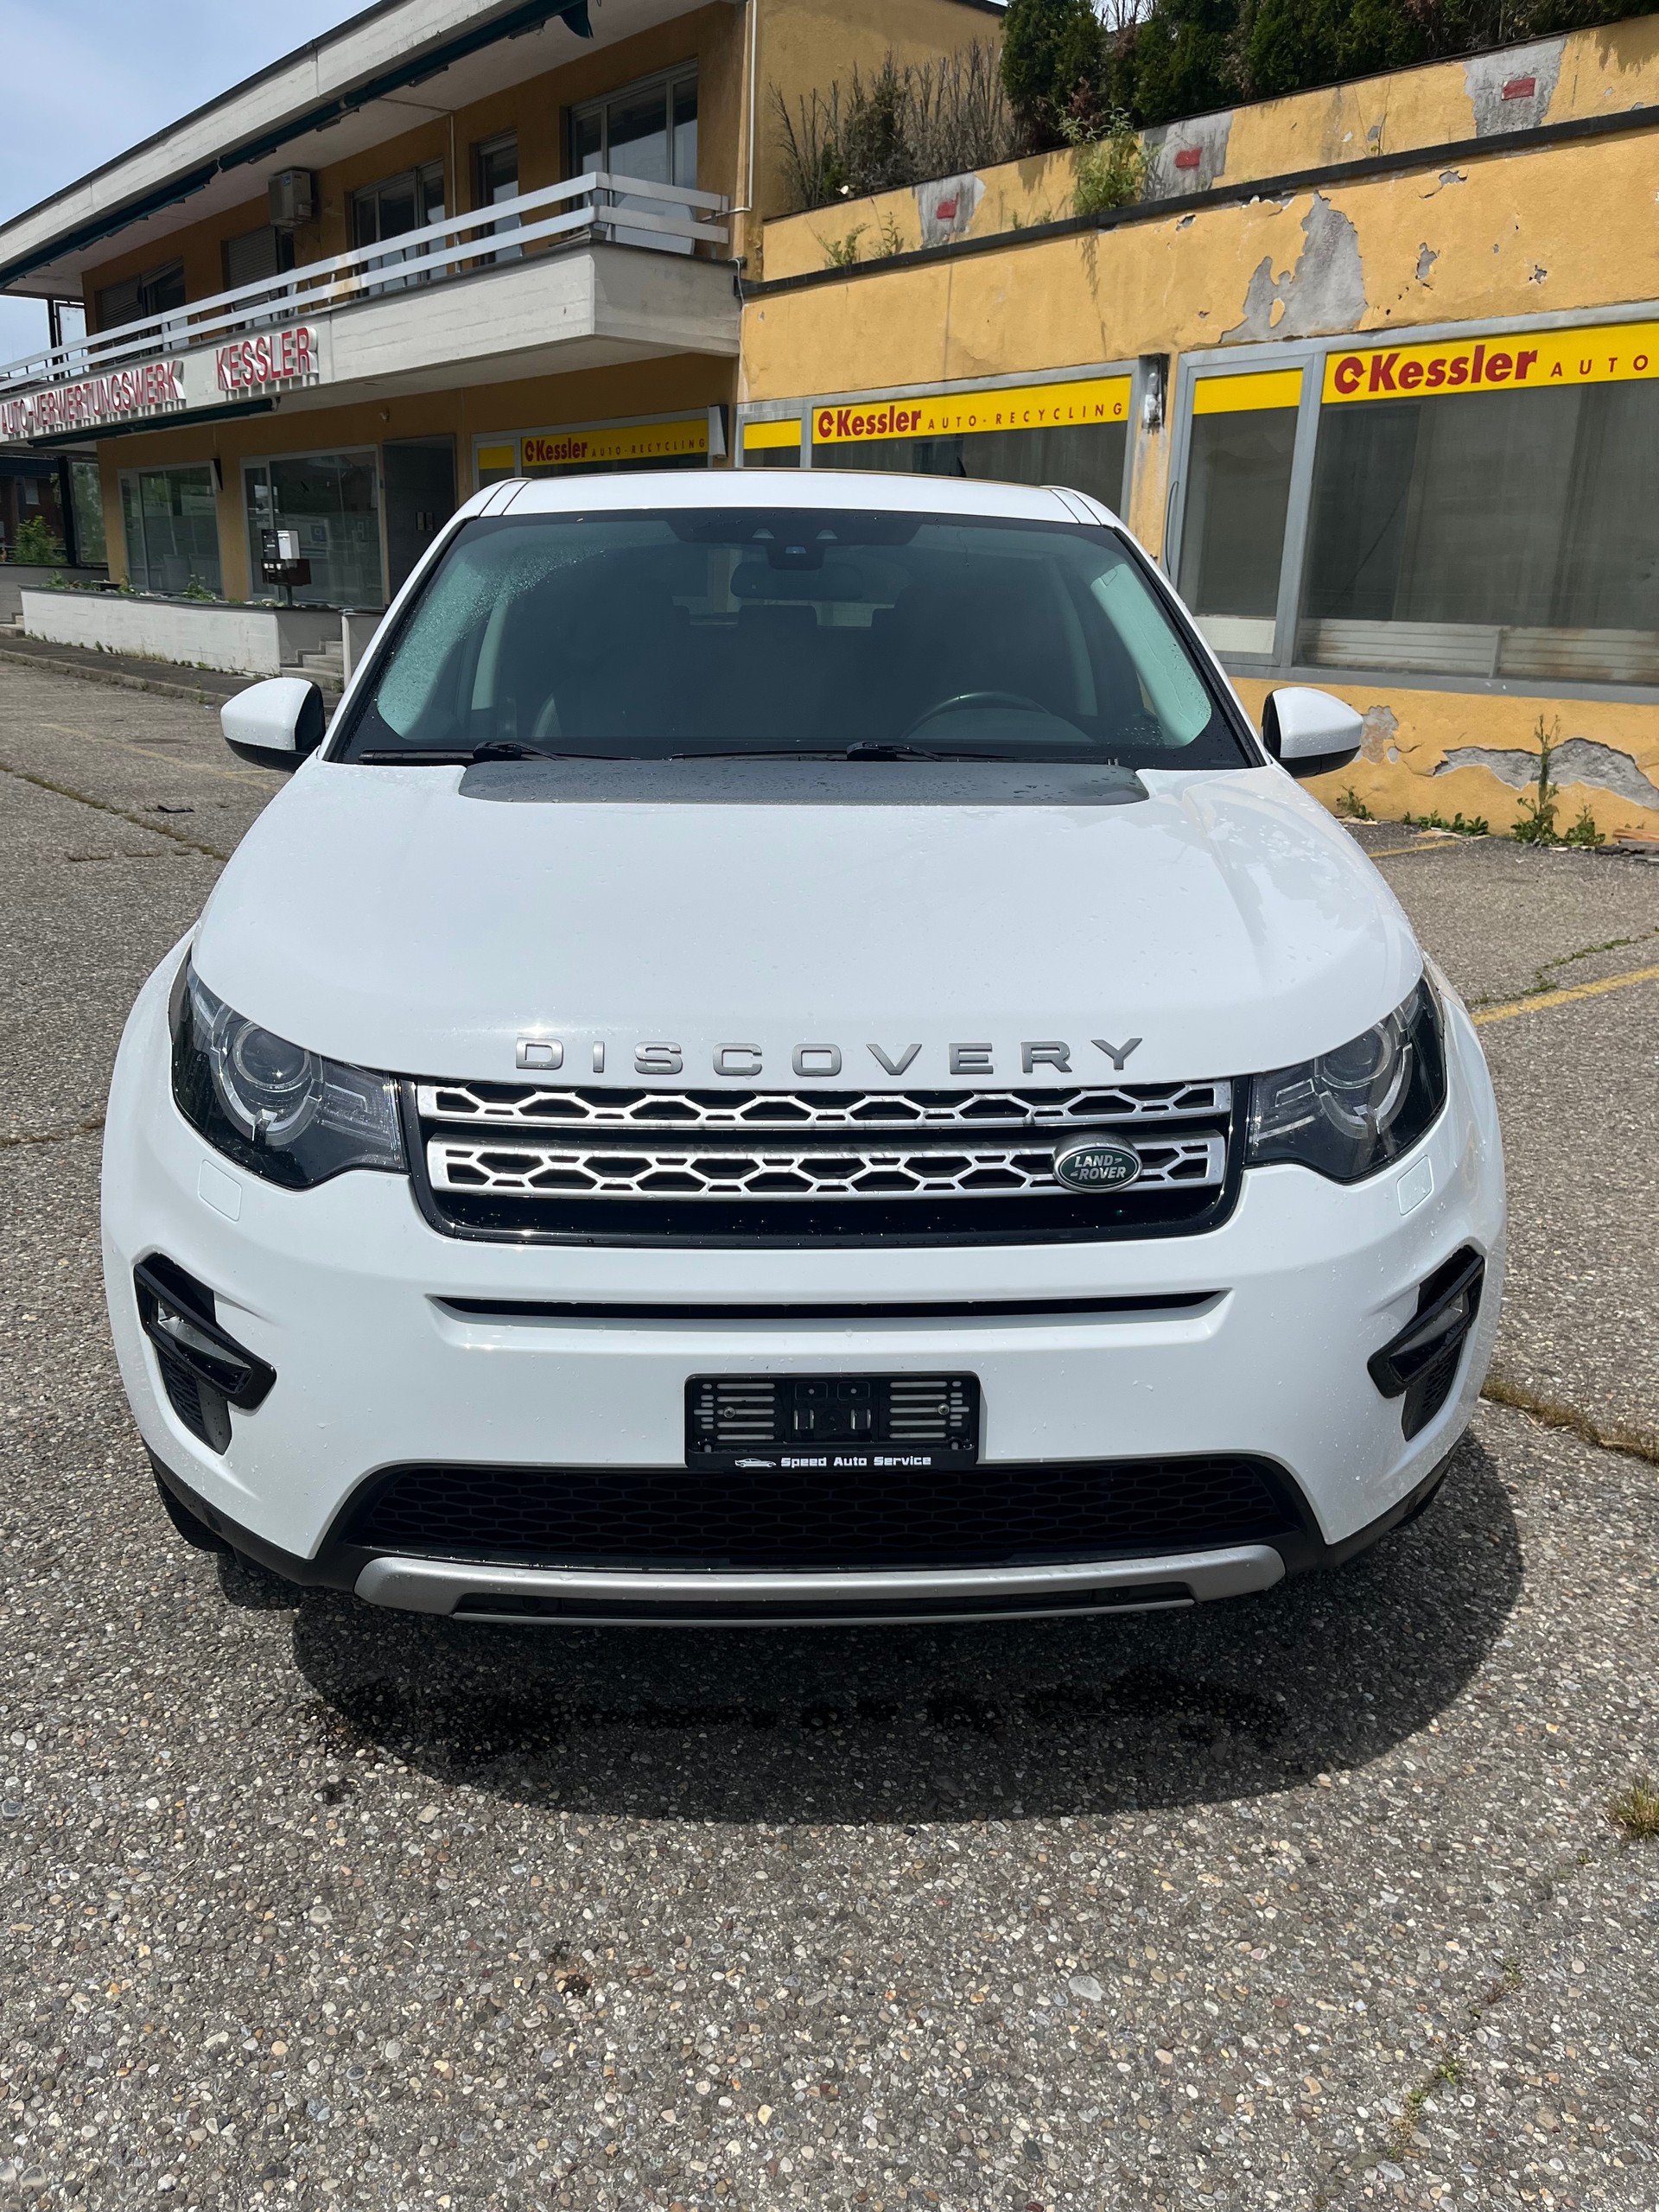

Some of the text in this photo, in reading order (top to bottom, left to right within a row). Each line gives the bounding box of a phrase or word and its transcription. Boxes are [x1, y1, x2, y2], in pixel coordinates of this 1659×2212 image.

[1, 327, 314, 434] AUTO-VERWERTUNGSWERK KESSLER
[1368, 344, 1649, 392] Kessler AUTO
[836, 405, 922, 437] Kessler
[536, 437, 588, 461] Kessler
[515, 1037, 1143, 1077] DISCOVERY
[1074, 1154, 1115, 1168] LAND
[1077, 1166, 1127, 1180] ROVER
[780, 1455, 931, 1468] Speed Auto Service
